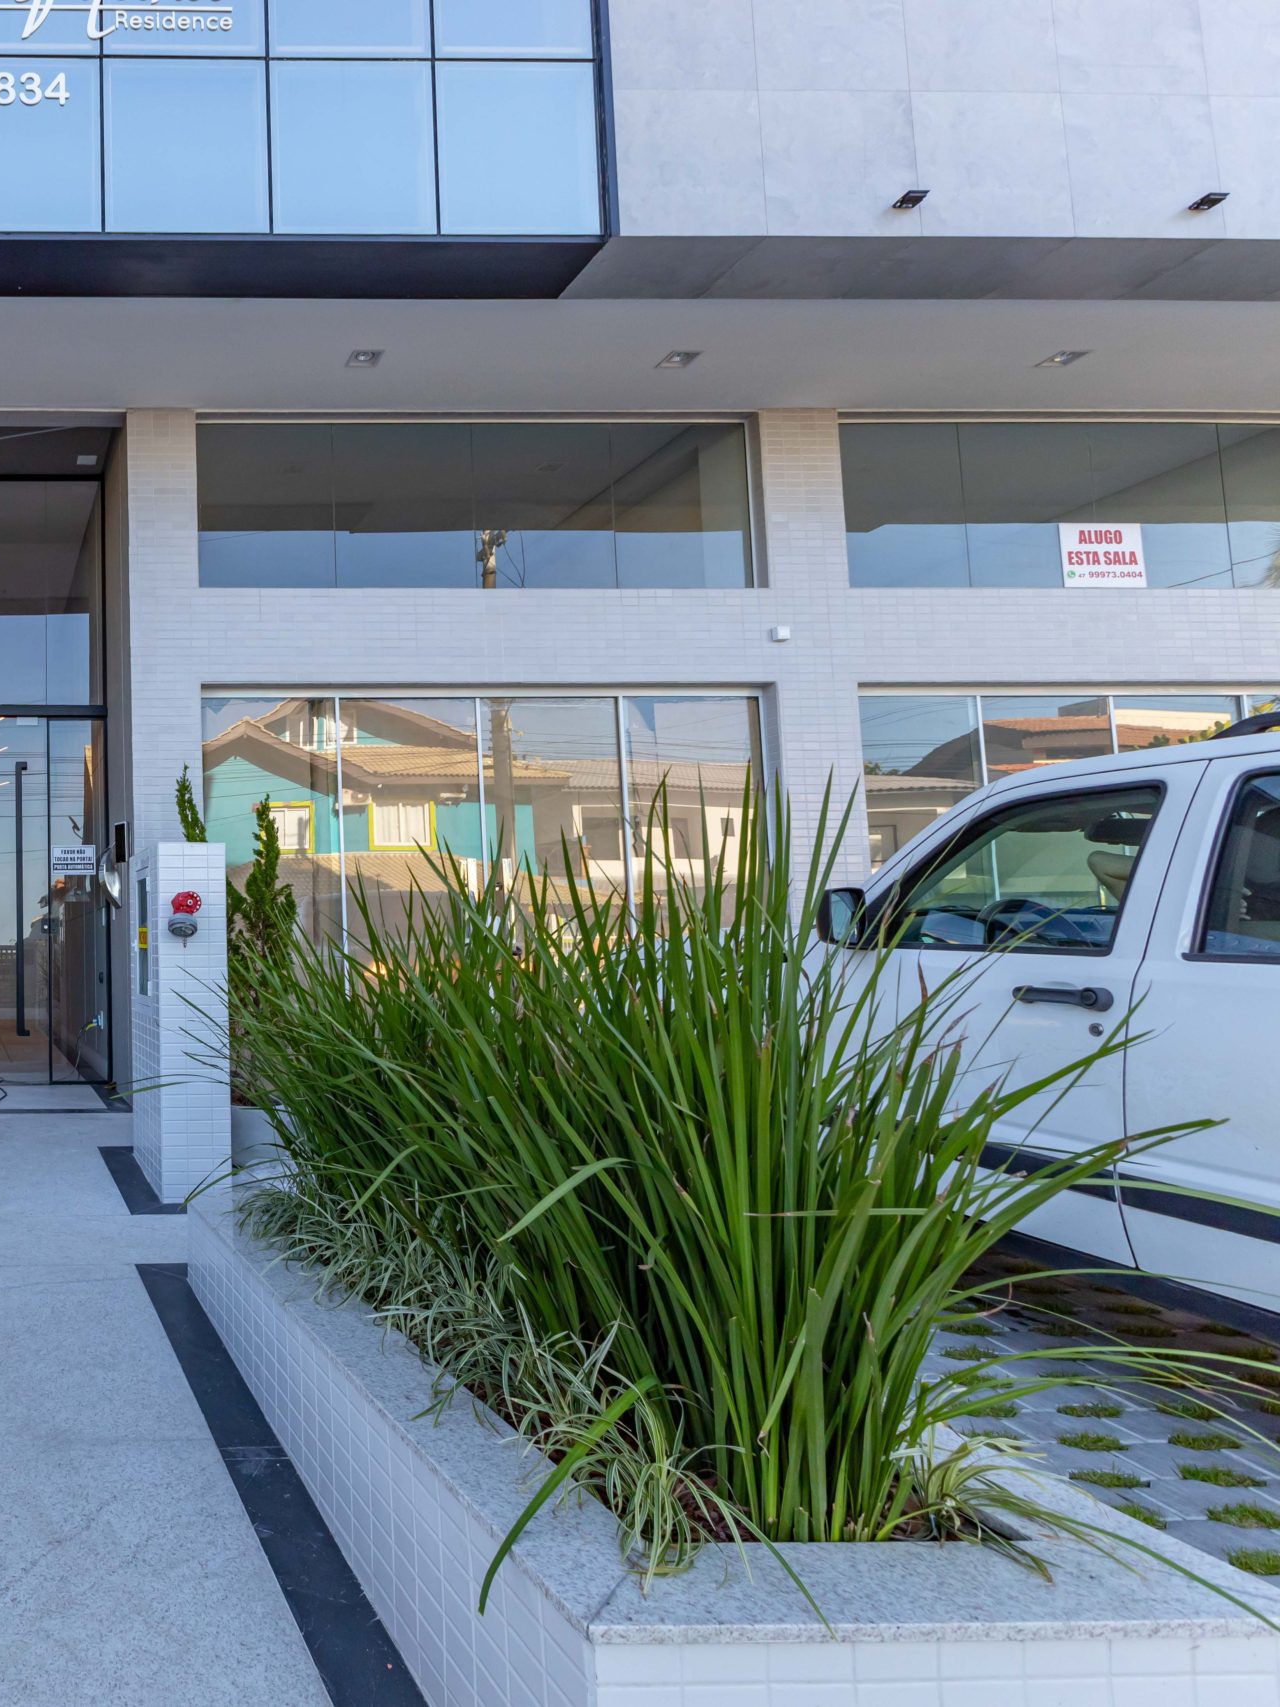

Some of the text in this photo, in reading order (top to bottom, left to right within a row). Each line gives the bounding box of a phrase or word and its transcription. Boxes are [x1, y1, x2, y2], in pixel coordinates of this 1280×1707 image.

[115, 10, 233, 31] Residence
[1078, 529, 1123, 545] ALUGO
[1067, 551, 1139, 566] ESTA SALA
[1088, 571, 1143, 579] 99973.0404
